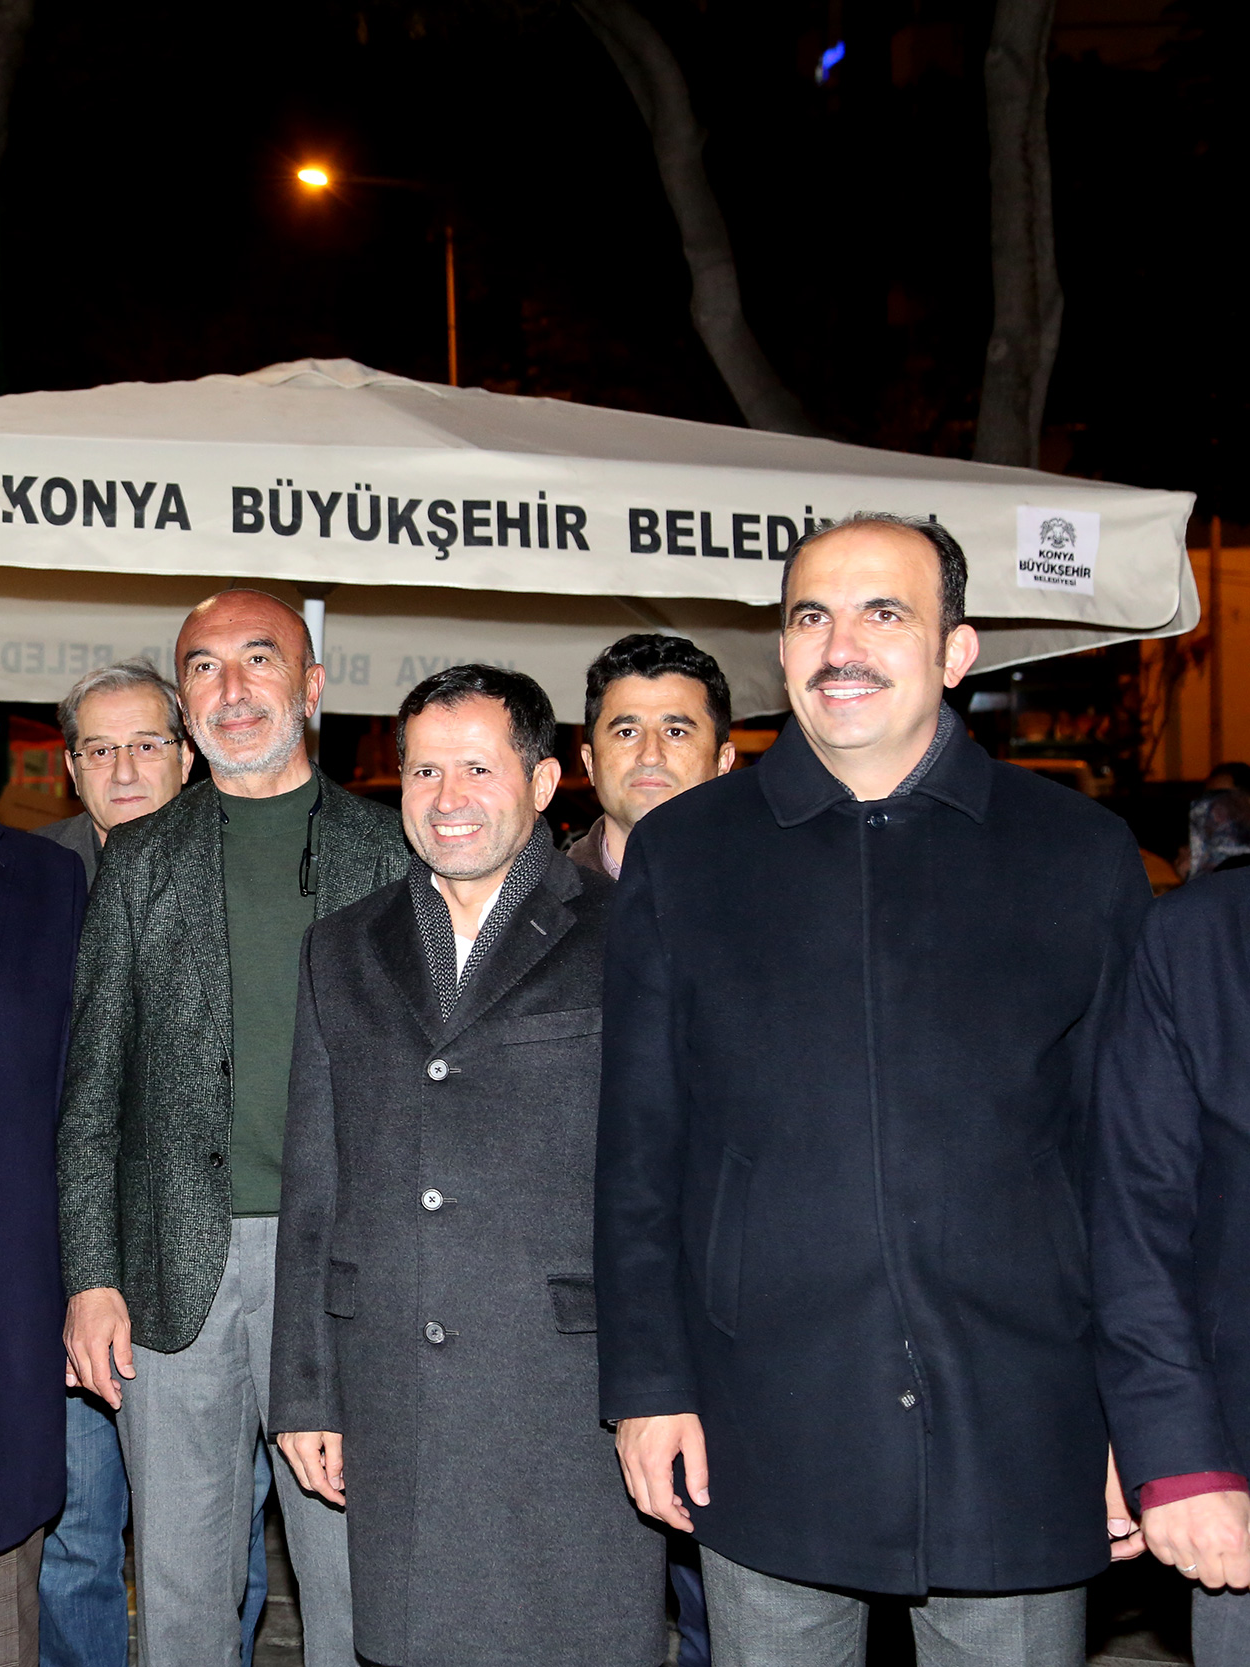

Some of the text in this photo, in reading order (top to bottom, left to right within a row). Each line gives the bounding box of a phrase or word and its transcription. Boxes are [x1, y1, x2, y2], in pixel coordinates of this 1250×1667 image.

[2, 474, 937, 561] KONYA BÜYÜKŞEHİR BELEDİ
[1039, 549, 1075, 561] KONYA
[1019, 558, 1091, 579] BÜYÜKŞEHİR
[1034, 575, 1077, 586] BELEDİYESİ
